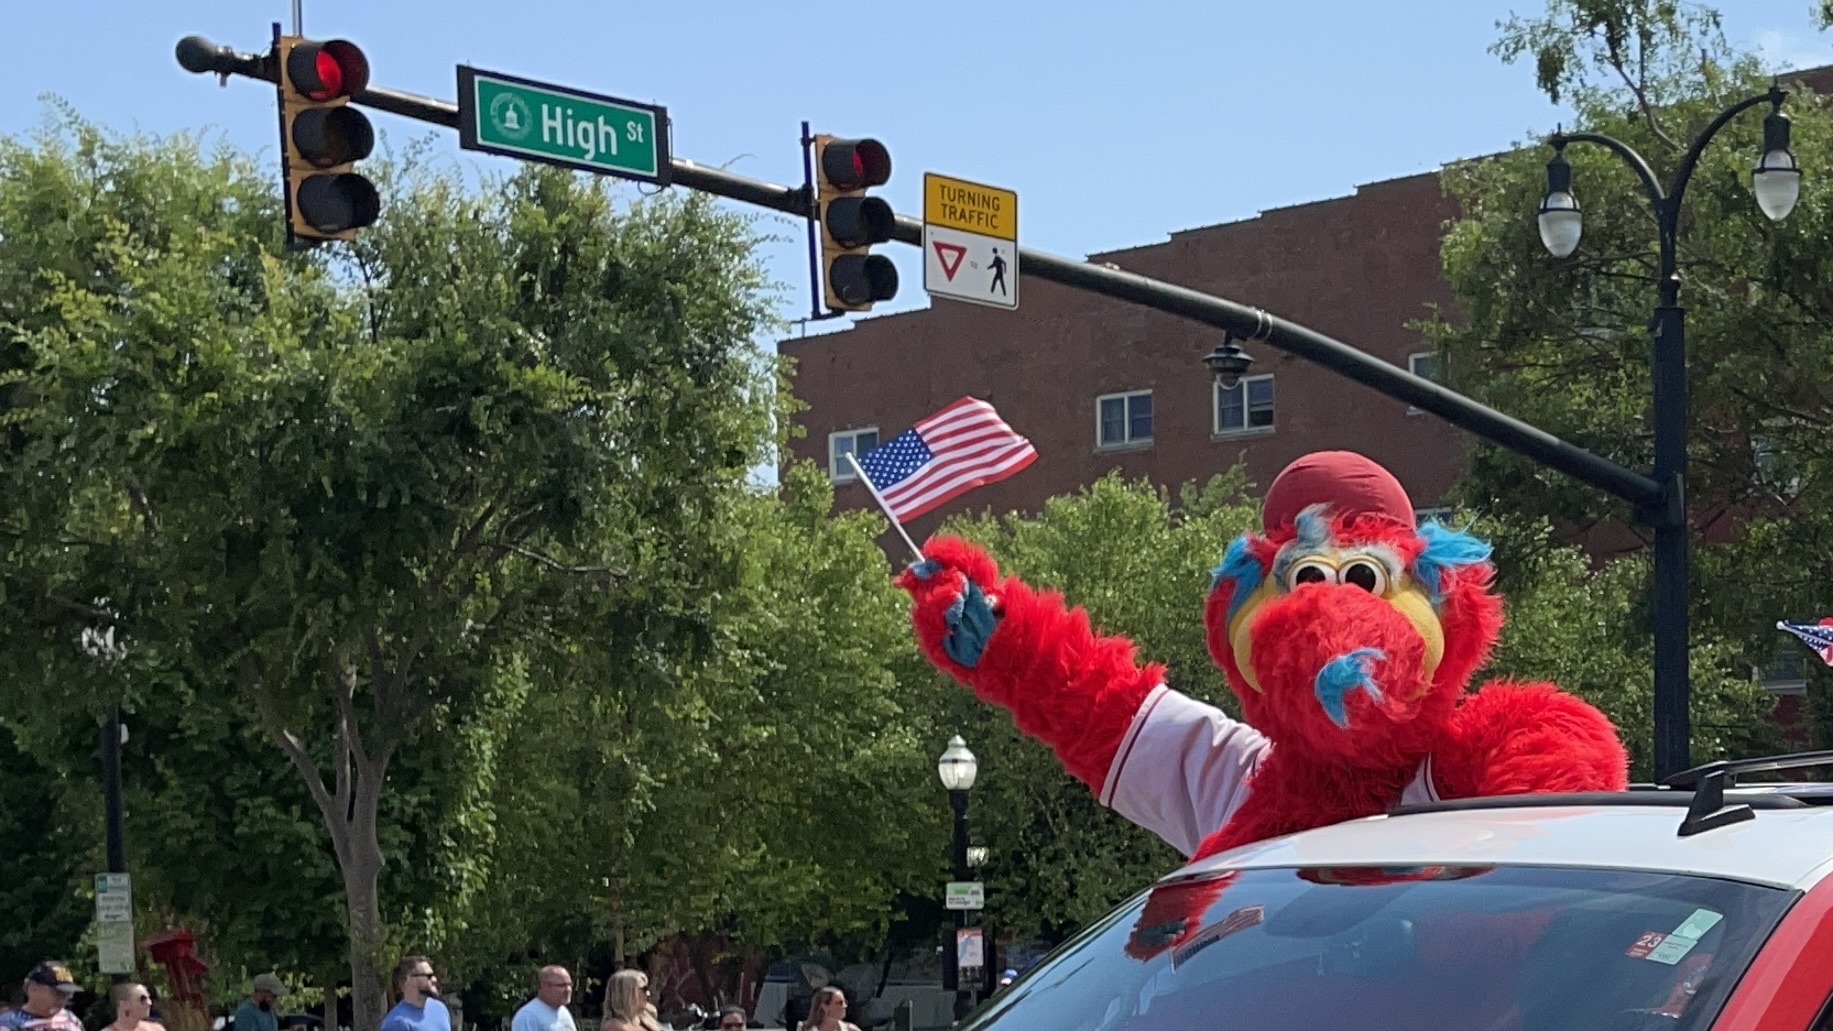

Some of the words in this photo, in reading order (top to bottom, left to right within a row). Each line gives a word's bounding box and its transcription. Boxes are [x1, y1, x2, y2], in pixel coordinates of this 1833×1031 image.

[541, 103, 618, 160] High
[626, 120, 644, 143] St
[939, 184, 1000, 212] TURNING
[941, 203, 999, 229] TRAFFIC
[1636, 934, 1662, 948] 23
